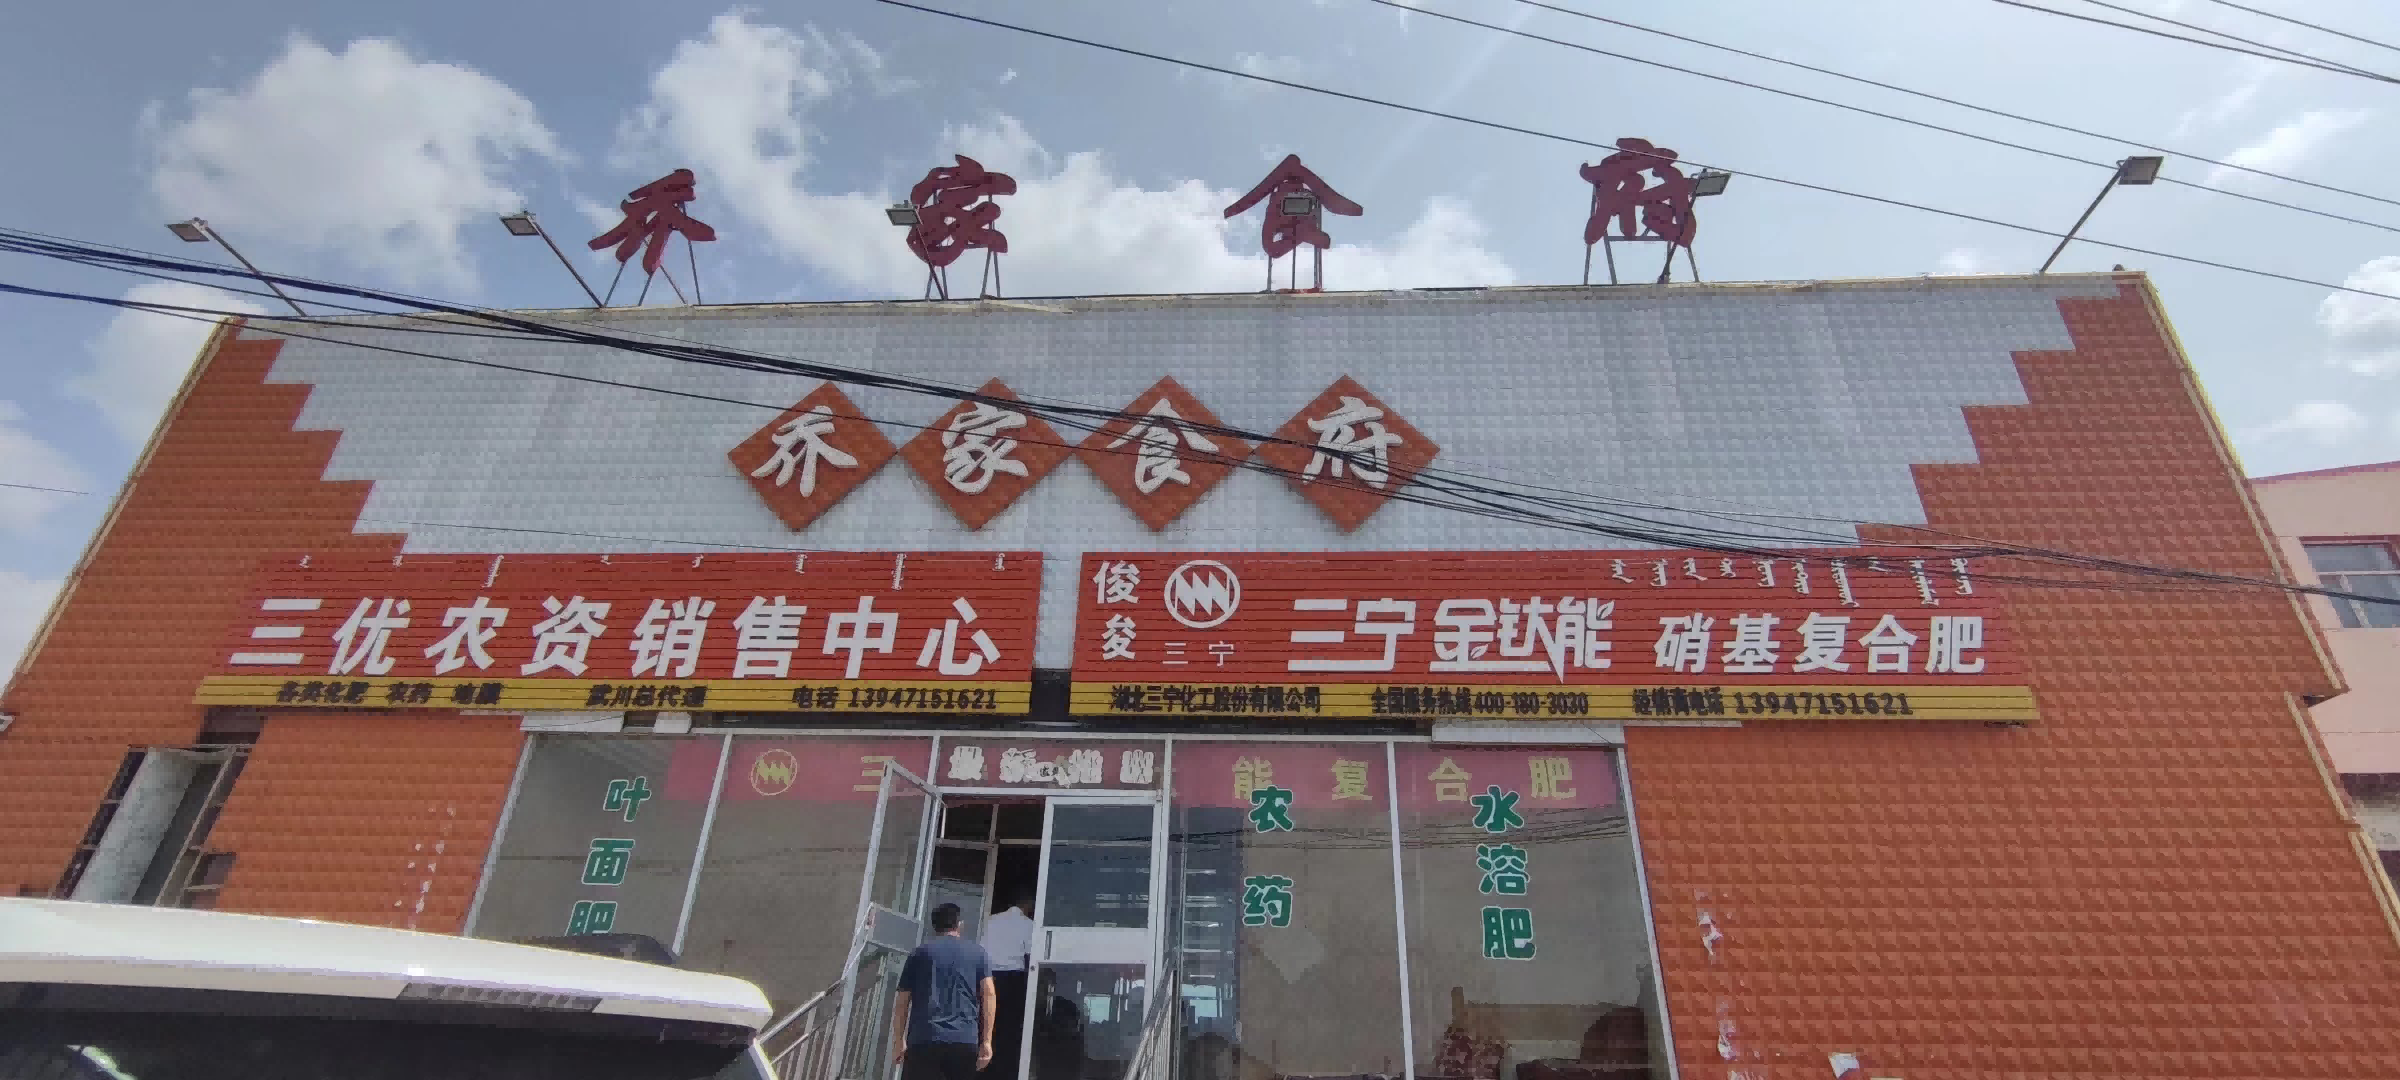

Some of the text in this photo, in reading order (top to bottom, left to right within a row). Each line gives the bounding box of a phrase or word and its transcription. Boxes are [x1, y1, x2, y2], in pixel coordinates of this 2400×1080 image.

[588, 138, 1697, 275] 乔家食府
[751, 397, 1403, 497] 乔家食府
[228, 596, 1001, 679] 三优农资销售中心
[1162, 641, 1234, 667] 三宁
[1287, 598, 1417, 672] 三宁
[1653, 611, 1985, 674] 硝基复合肥
[385, 682, 434, 705] 农药
[586, 684, 708, 709] 武川总代理
[793, 685, 839, 710] 电话
[848, 687, 997, 710] 13947151621
[1110, 684, 1321, 713] 湖北三宁化工股份有限公司
[1632, 686, 1725, 715] 经销商电话
[1734, 691, 1914, 716] 13947151621
[564, 776, 652, 937] 叶面肥
[1242, 784, 1293, 928] 农药
[1471, 784, 1537, 960] 水溶肥
